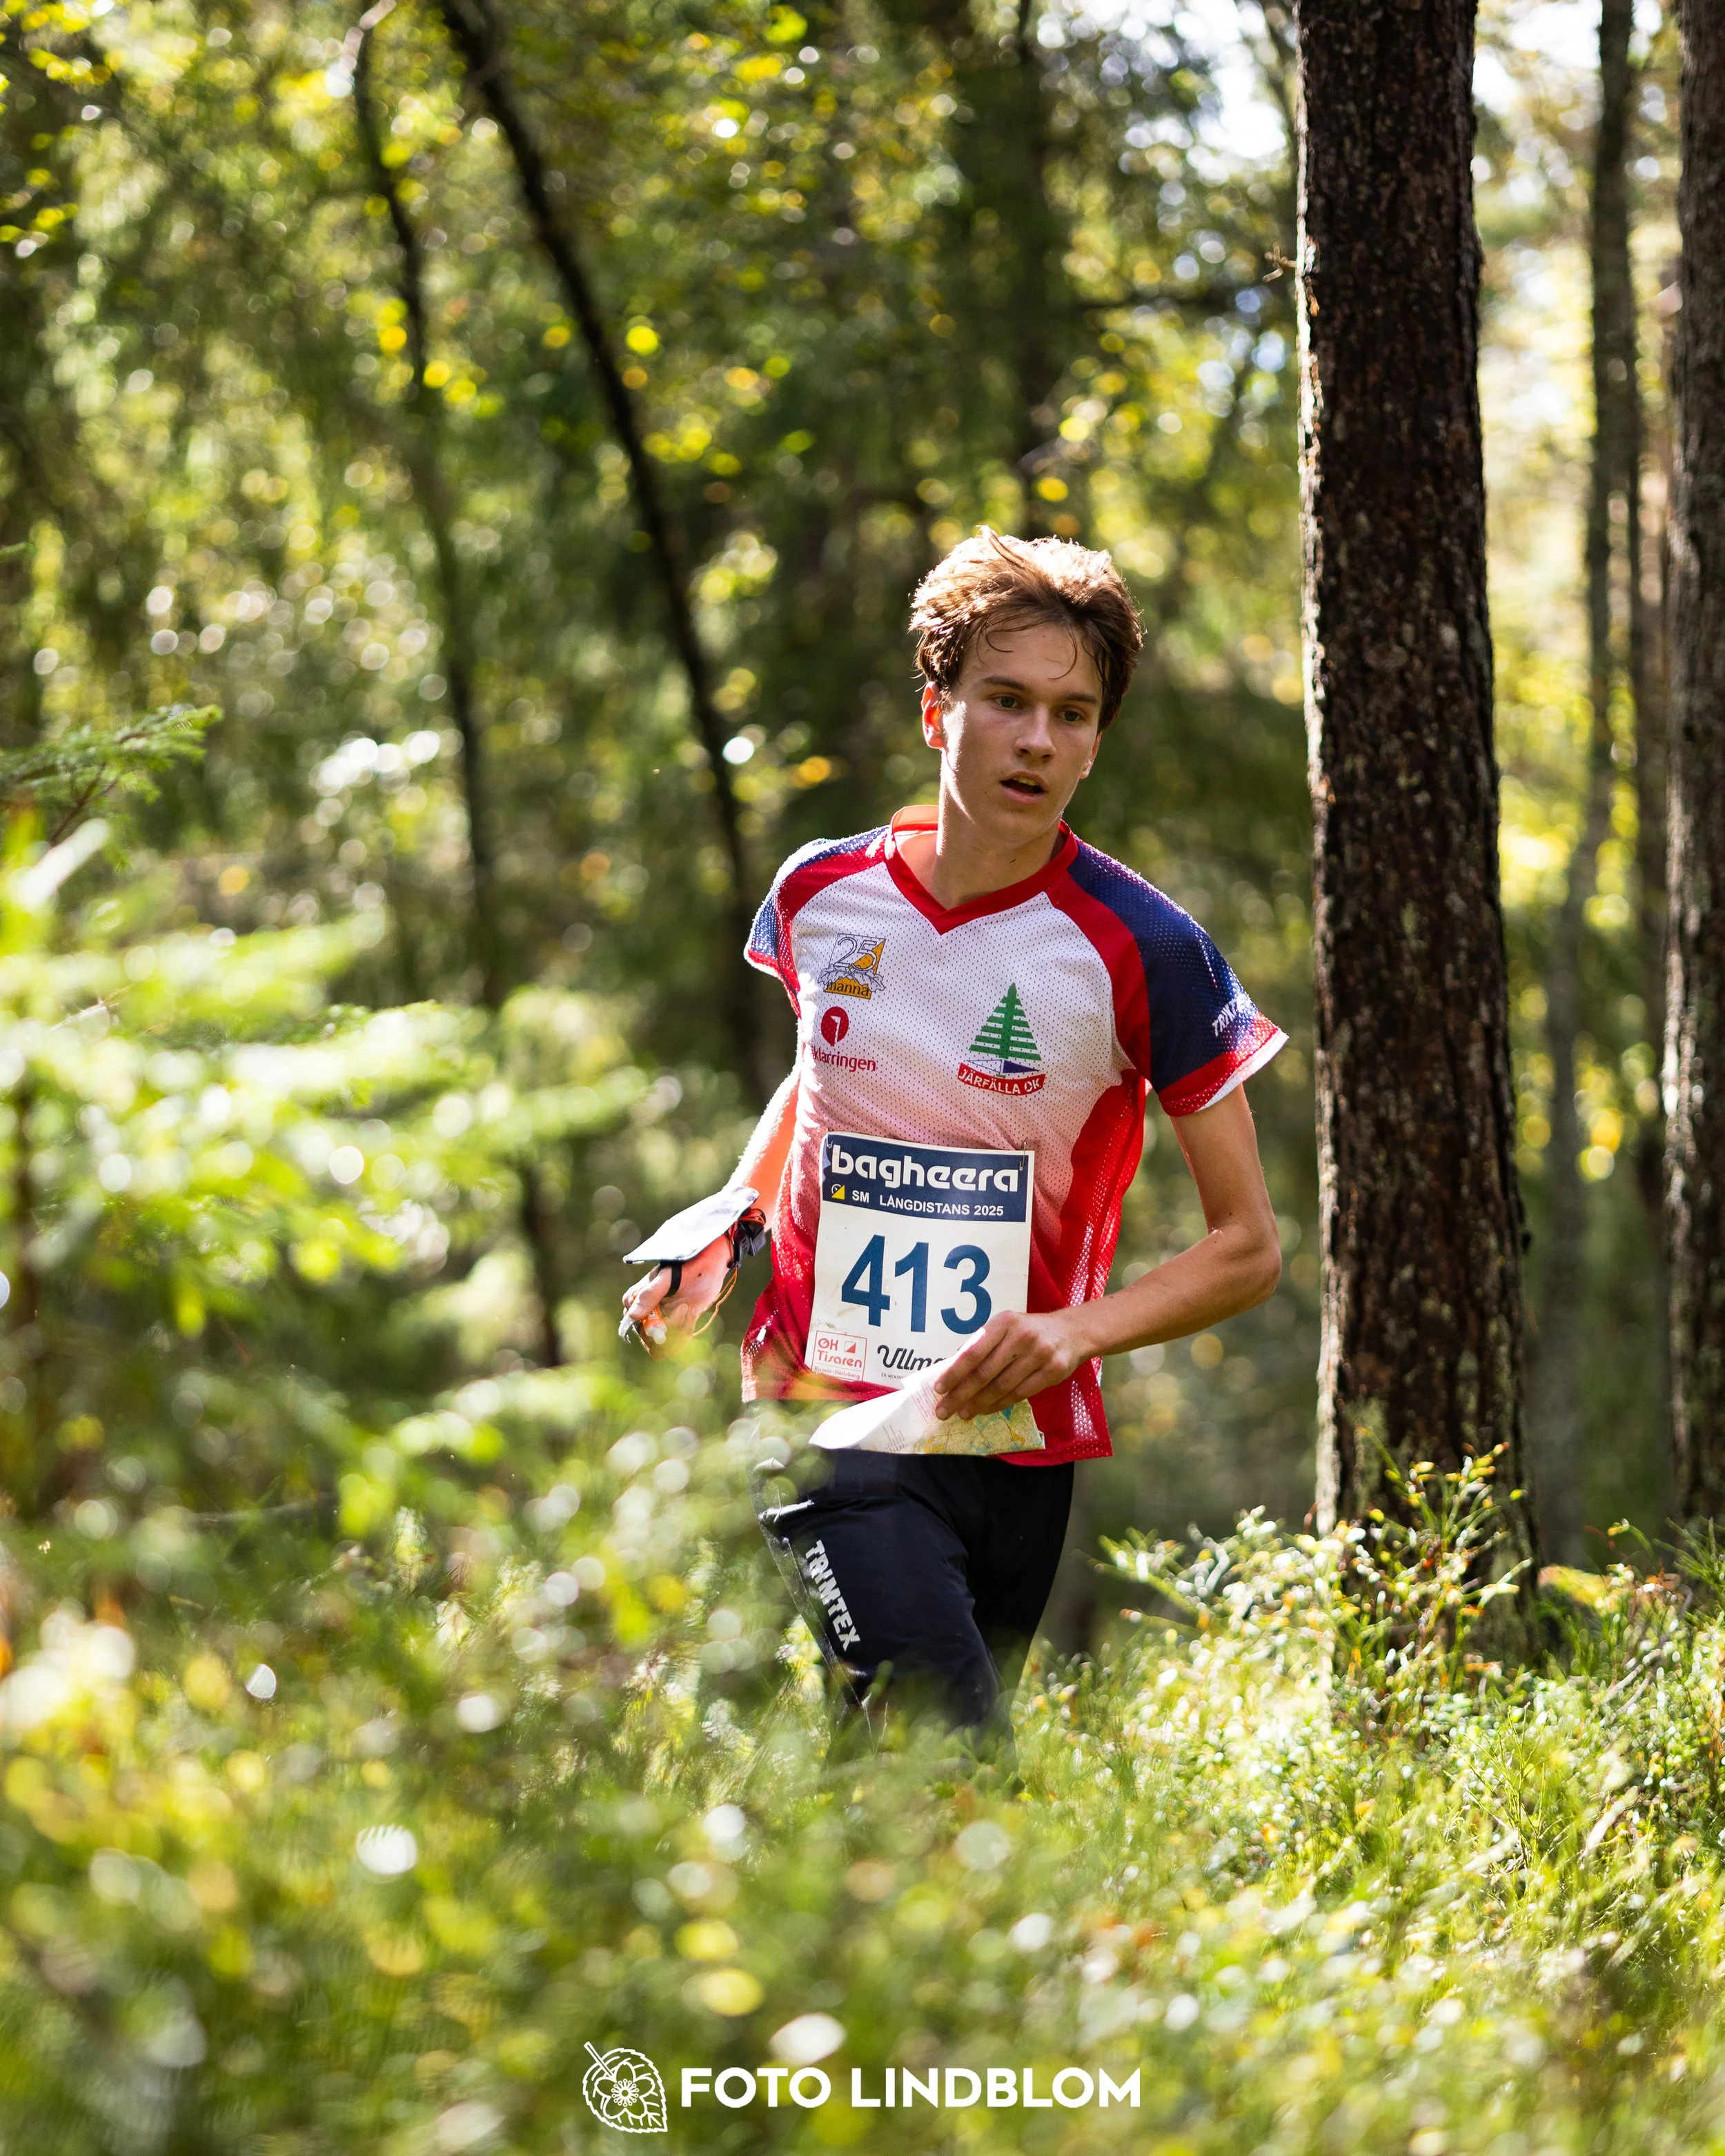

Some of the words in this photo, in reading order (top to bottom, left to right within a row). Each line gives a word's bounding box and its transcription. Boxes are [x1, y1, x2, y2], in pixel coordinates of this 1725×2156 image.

[833, 936, 878, 972] 25
[958, 1069, 1021, 1094] JÄRFÄLLA
[1024, 1078, 1041, 1092] OK
[831, 1144, 1019, 1192] bagheera
[851, 1189, 870, 1203] SM
[879, 1194, 970, 1216] LÅNGDISTANS
[974, 1205, 1004, 1216] 2025
[841, 1234, 992, 1335] 413
[817, 1349, 862, 1369] Tisaren
[805, 1539, 861, 1652] TRIMTEX
